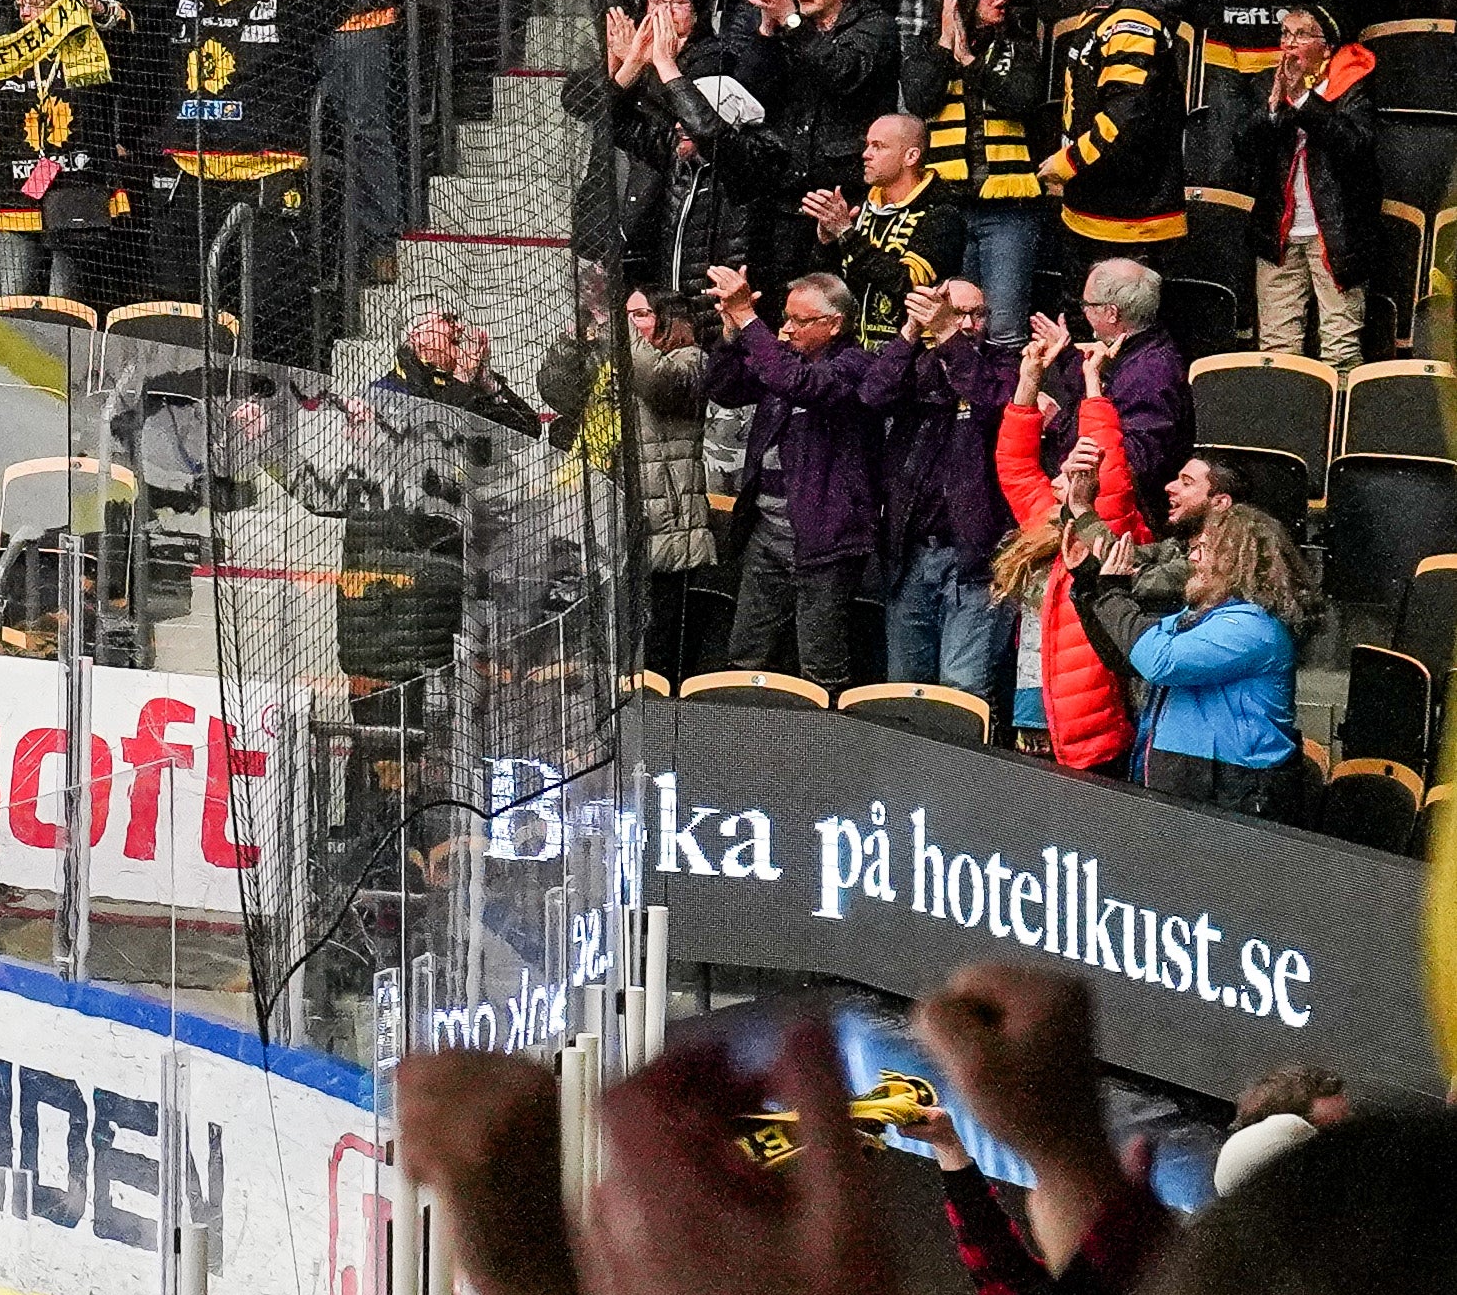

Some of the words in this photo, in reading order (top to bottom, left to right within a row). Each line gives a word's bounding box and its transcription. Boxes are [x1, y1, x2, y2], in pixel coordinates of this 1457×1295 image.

[482, 757, 784, 879] Bka
[815, 801, 895, 921] på
[910, 807, 1314, 1028] hotellkust.se
